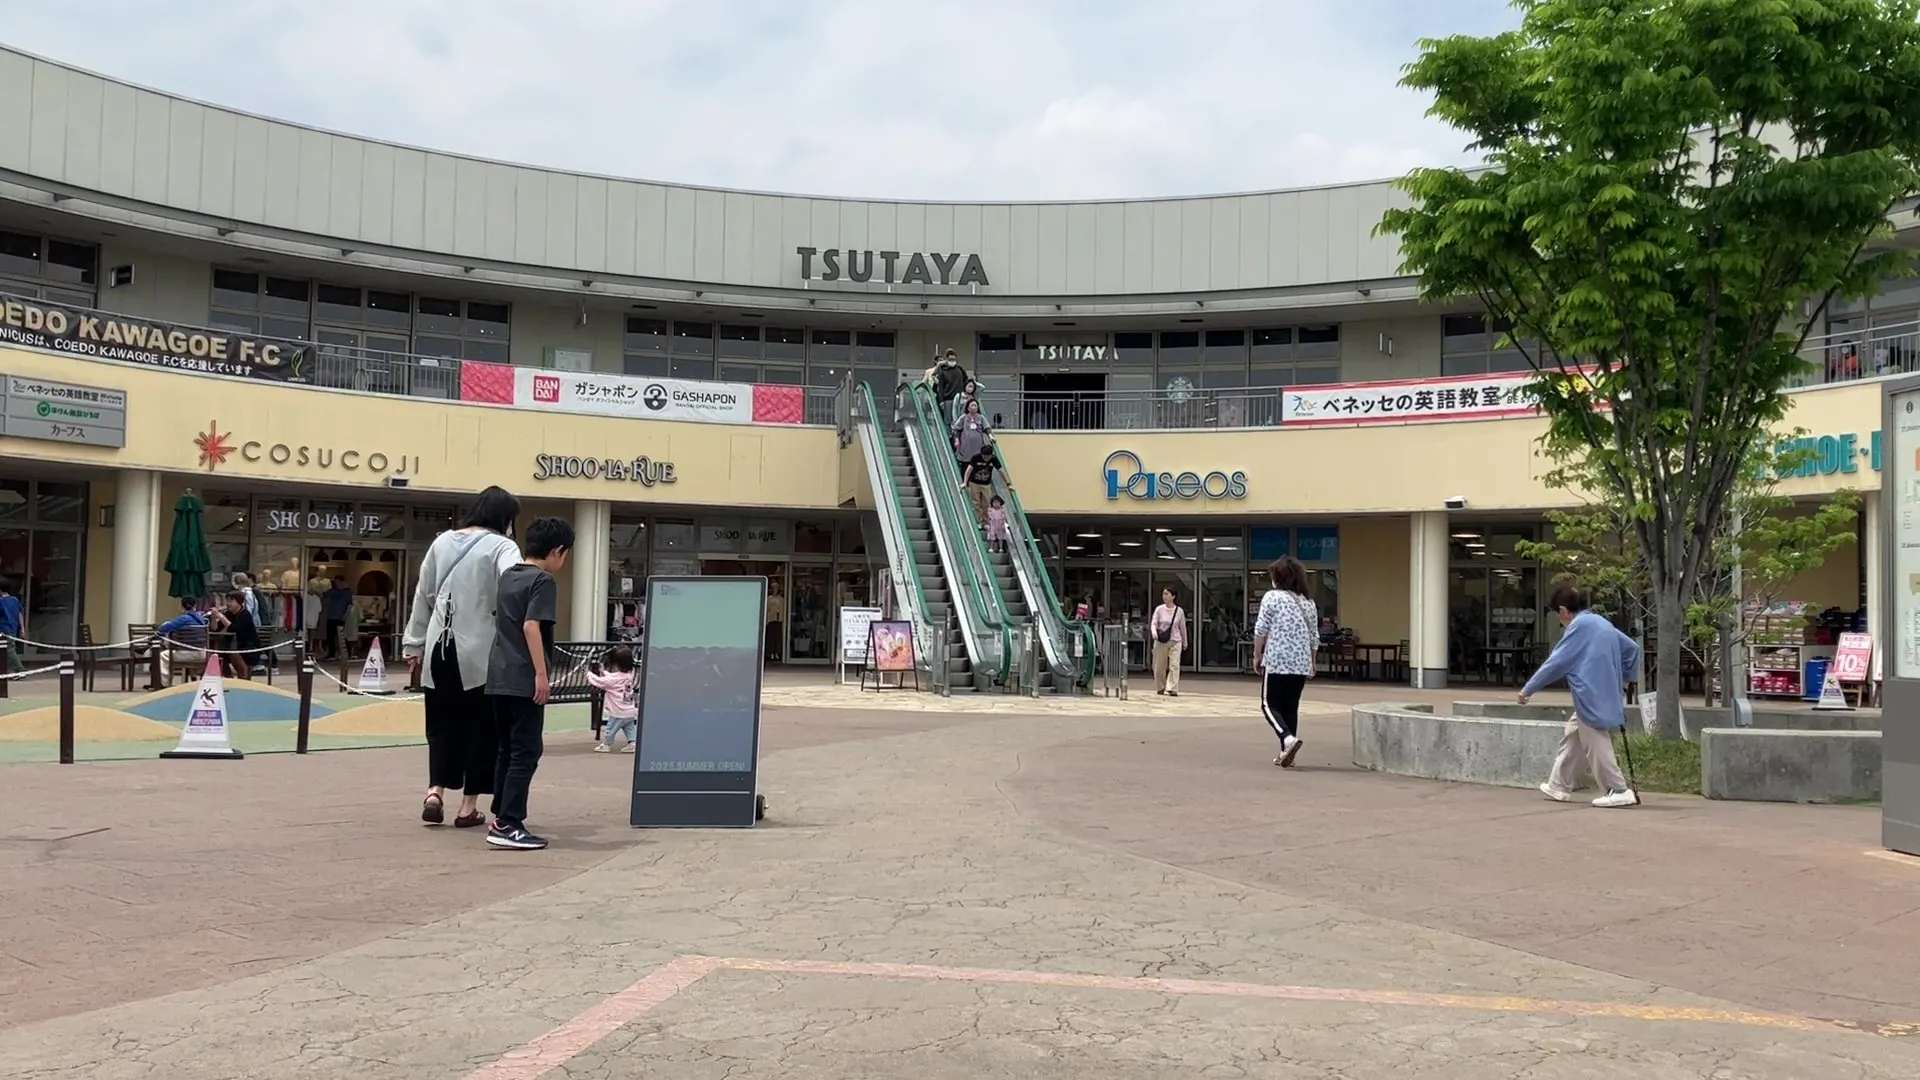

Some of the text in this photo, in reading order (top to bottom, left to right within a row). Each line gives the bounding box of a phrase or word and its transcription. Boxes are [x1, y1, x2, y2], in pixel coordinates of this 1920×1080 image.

[797, 246, 990, 286] TSUTAYA
[0, 301, 281, 366] EDO KAWAGOE F.C
[54, 338, 96, 354] COEDO
[100, 346, 158, 364] KAWAGOE
[27, 384, 99, 401] ベネッセの英語教室
[535, 380, 558, 390] BAN
[535, 389, 553, 399] DAI
[575, 382, 638, 398] ガシャポン
[673, 391, 736, 404] GASHAPON
[1323, 386, 1501, 414] ベネッセの英語教室
[241, 441, 419, 474] COSUCOJI
[1103, 450, 1248, 499] Paseos
